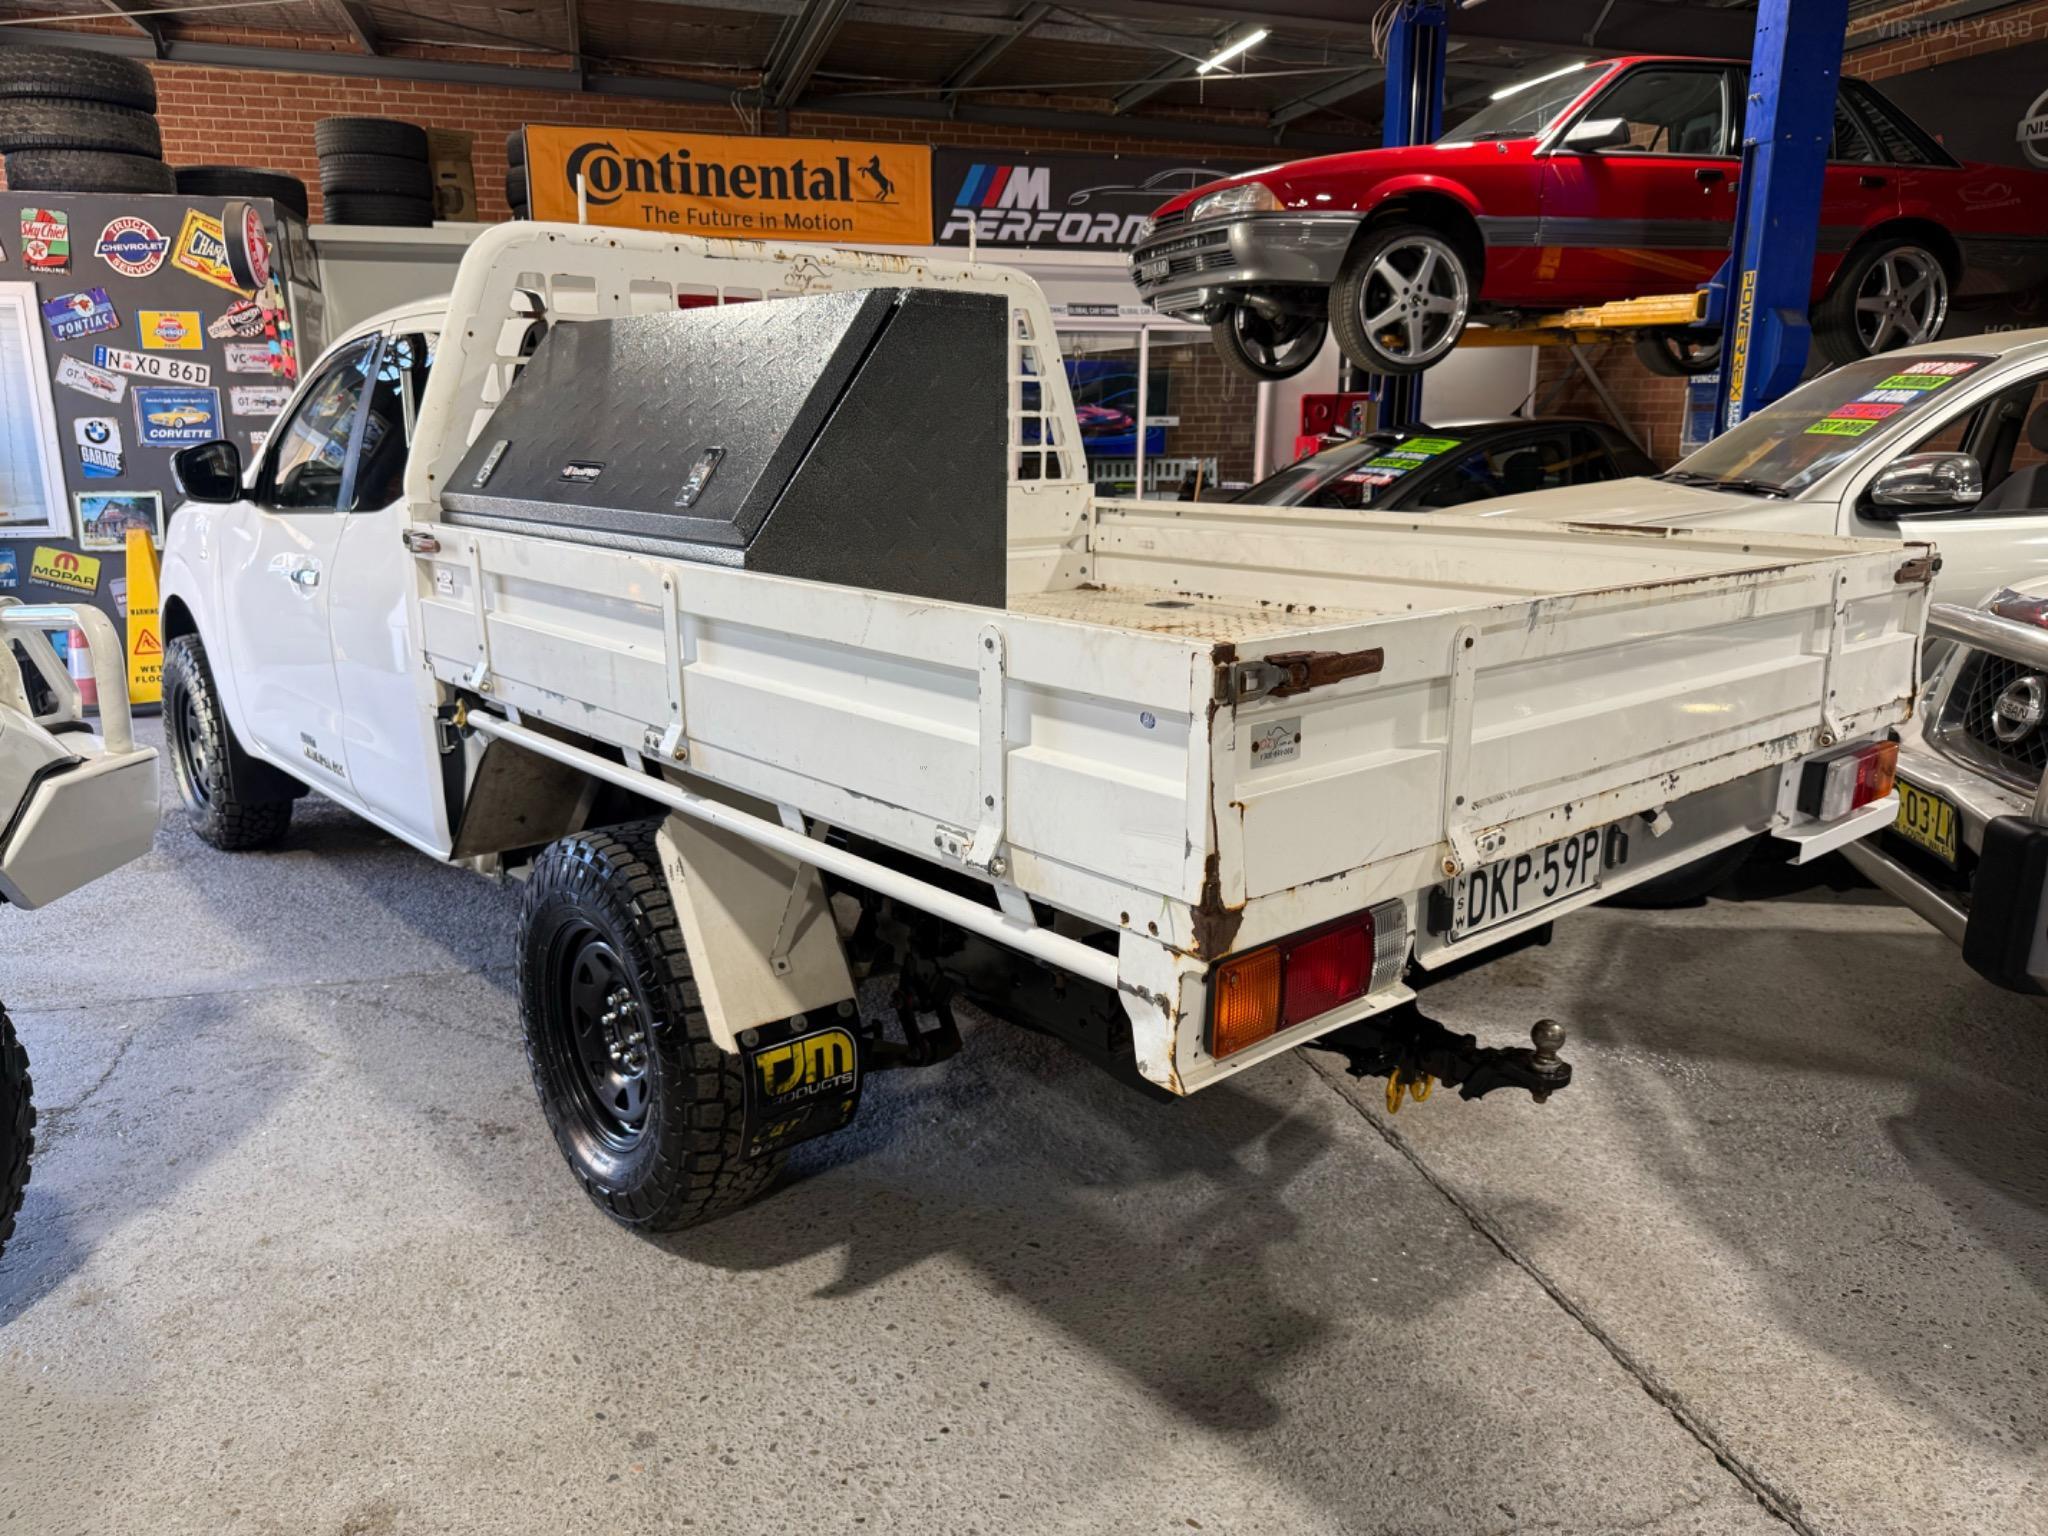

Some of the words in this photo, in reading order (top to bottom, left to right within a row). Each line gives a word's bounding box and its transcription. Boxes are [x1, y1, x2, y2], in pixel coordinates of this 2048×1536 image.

[567, 142, 853, 205] Continental
[109, 220, 150, 234] TRUCK
[641, 205, 679, 225] The
[687, 208, 753, 229] Future
[760, 211, 777, 229] in
[783, 213, 853, 232] Motion
[101, 243, 164, 252] CHEVROLET
[112, 256, 160, 275] SERVICE
[58, 312, 110, 337] PONTIAC
[150, 429, 213, 439] CORVETTE
[33, 565, 95, 586] MOPAR
